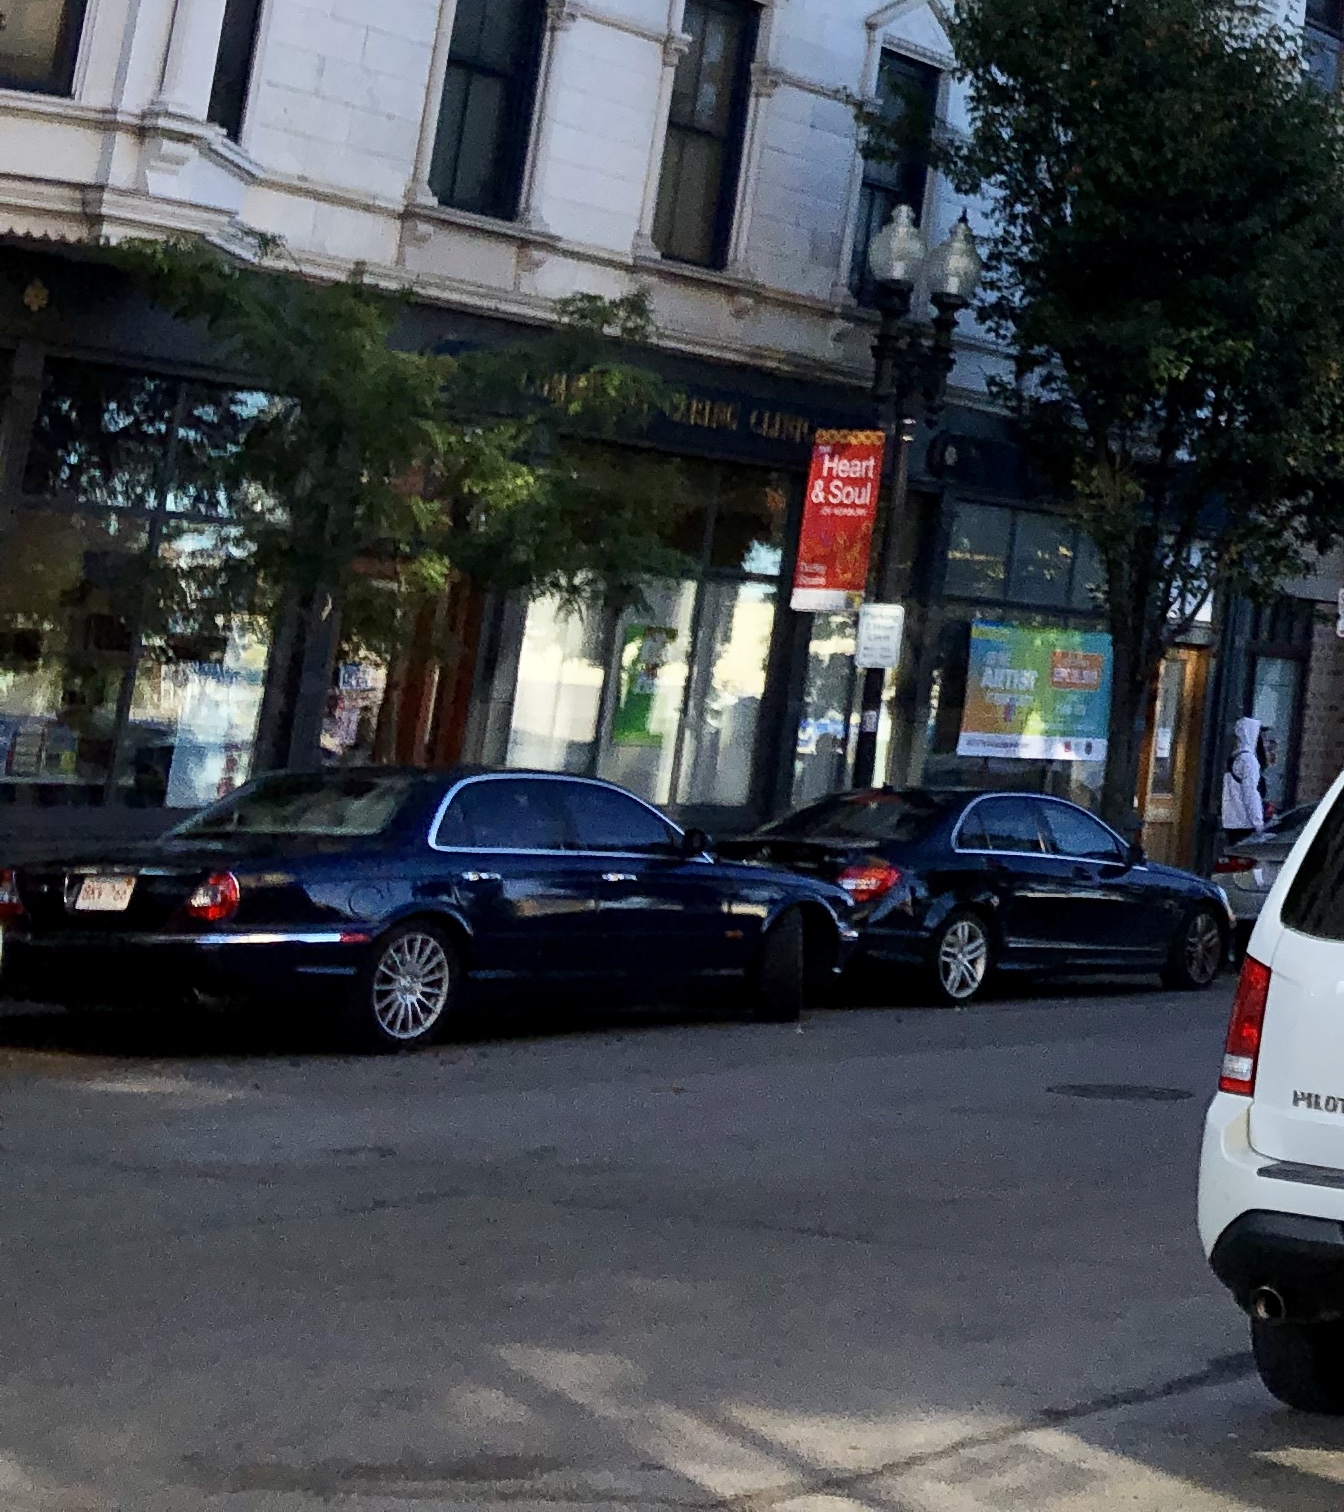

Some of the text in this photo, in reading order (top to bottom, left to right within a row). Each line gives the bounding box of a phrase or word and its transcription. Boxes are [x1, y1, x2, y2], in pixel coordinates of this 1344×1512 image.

[822, 454, 875, 480] Heart
[811, 478, 872, 506] & Soul
